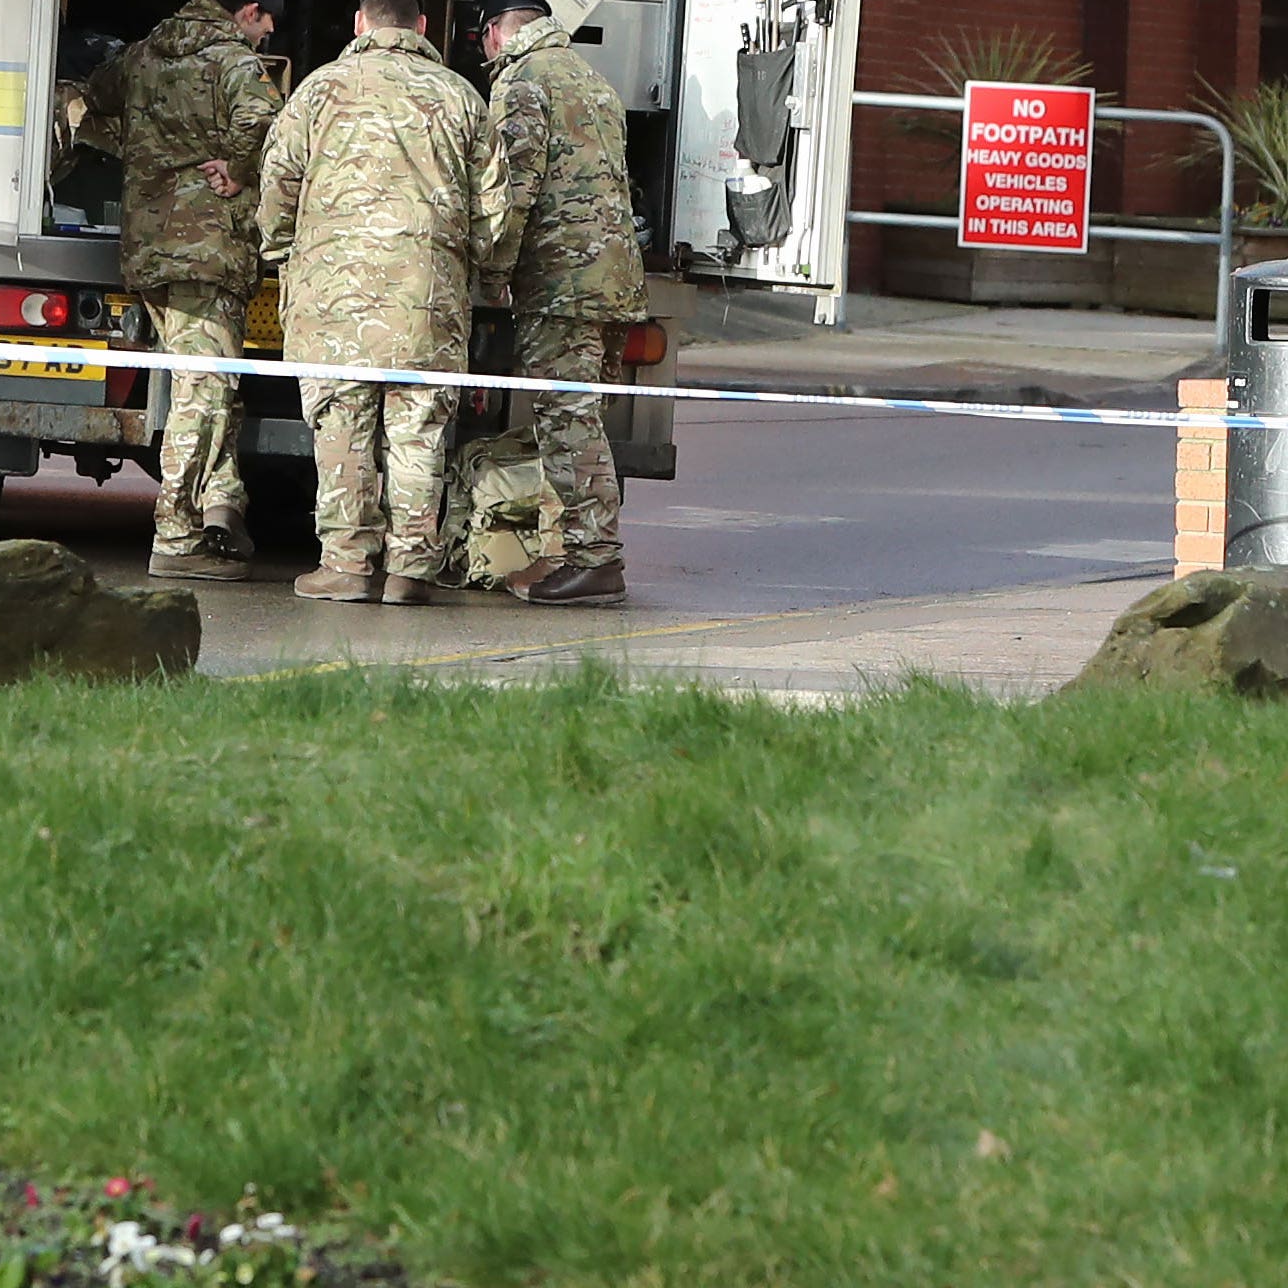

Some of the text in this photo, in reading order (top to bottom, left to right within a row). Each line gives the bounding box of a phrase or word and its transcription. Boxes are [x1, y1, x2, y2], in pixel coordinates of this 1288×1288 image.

[1013, 99, 1046, 119] NO
[971, 122, 1085, 147] FOOTPATH
[967, 148, 1088, 171] HEAVY GOODS
[984, 172, 1068, 192] VEHICLES
[975, 194, 1074, 215] OPERATING
[968, 217, 1079, 239] IN THIS AREA
